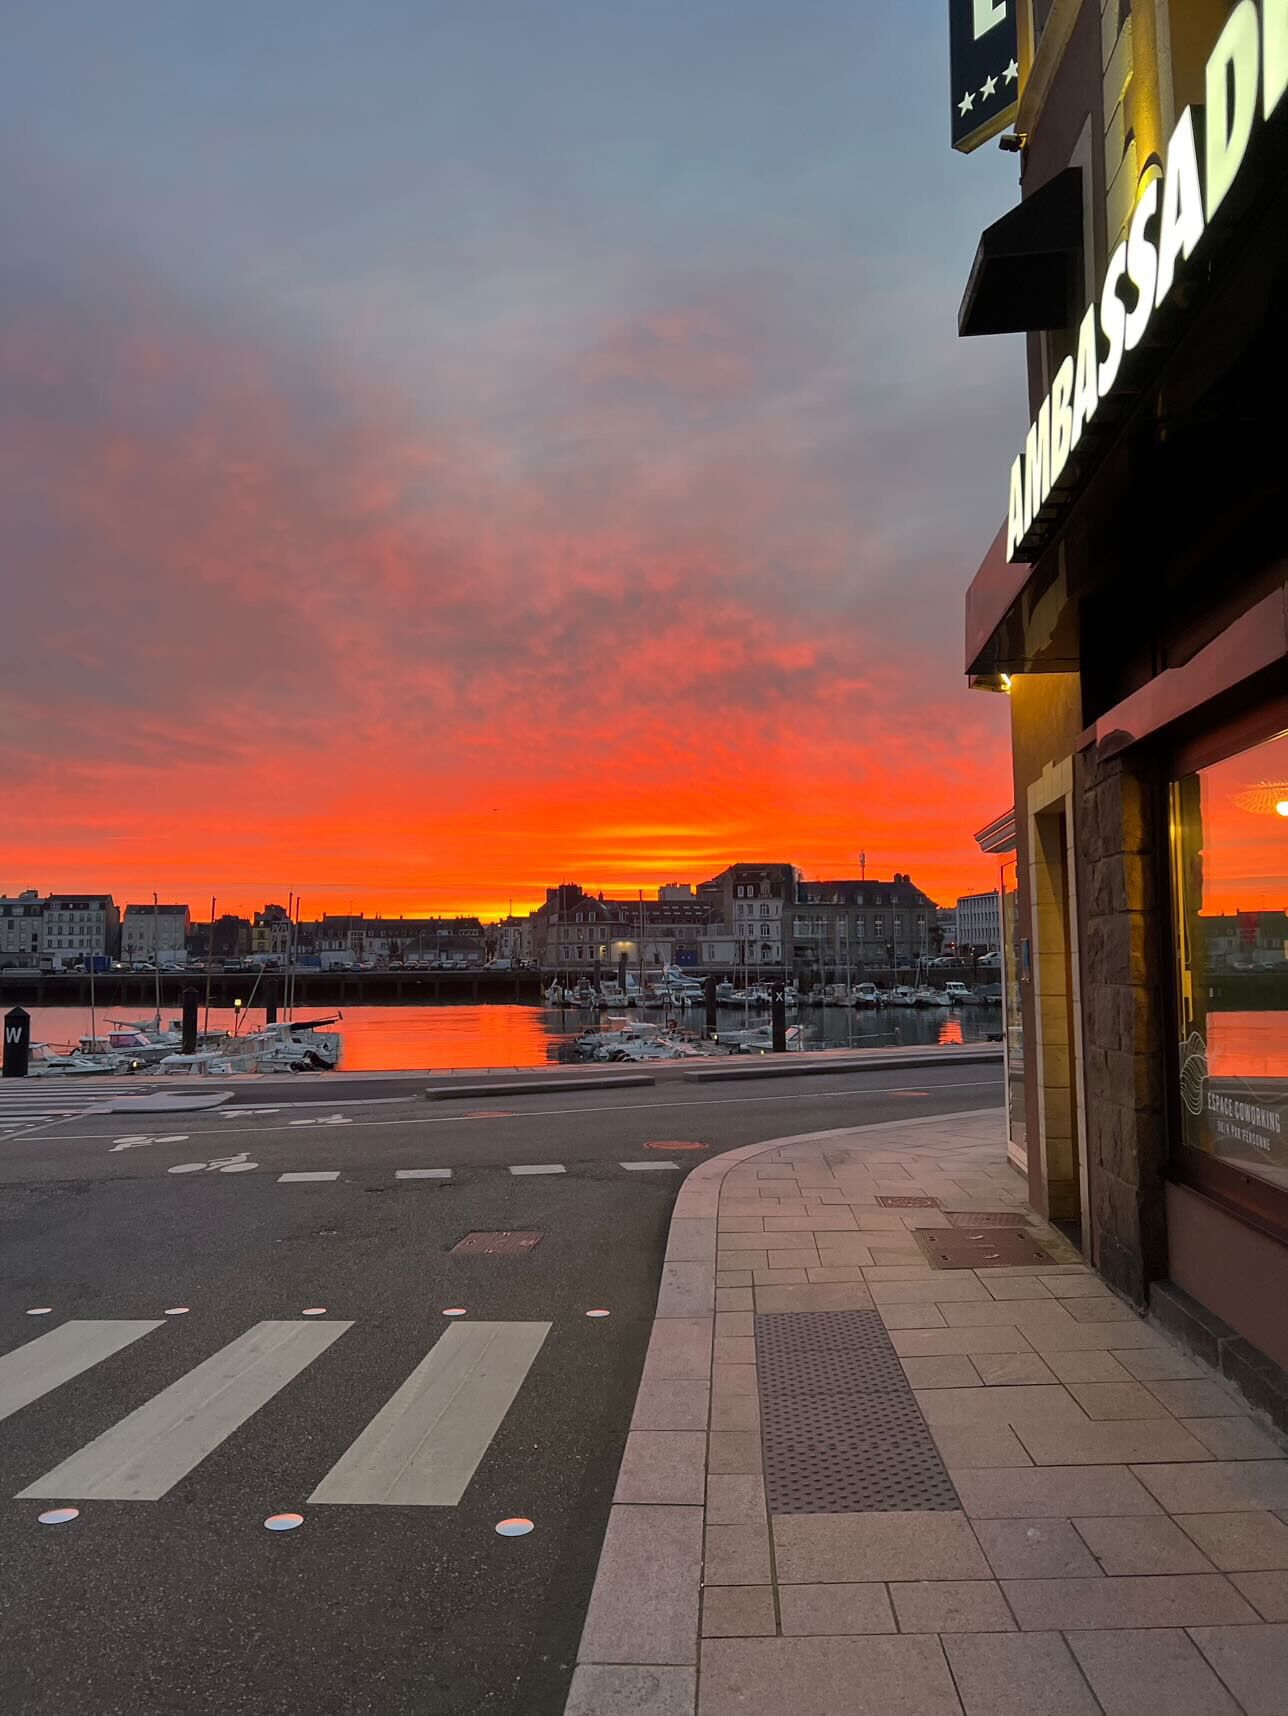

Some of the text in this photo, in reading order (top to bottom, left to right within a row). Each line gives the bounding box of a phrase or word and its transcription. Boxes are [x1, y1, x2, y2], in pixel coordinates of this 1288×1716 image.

[775, 991, 784, 1002] X
[6, 1026, 22, 1043] W
[1207, 1092, 1233, 1117] ESPACE
[1234, 1100, 1281, 1133] COWORKING
